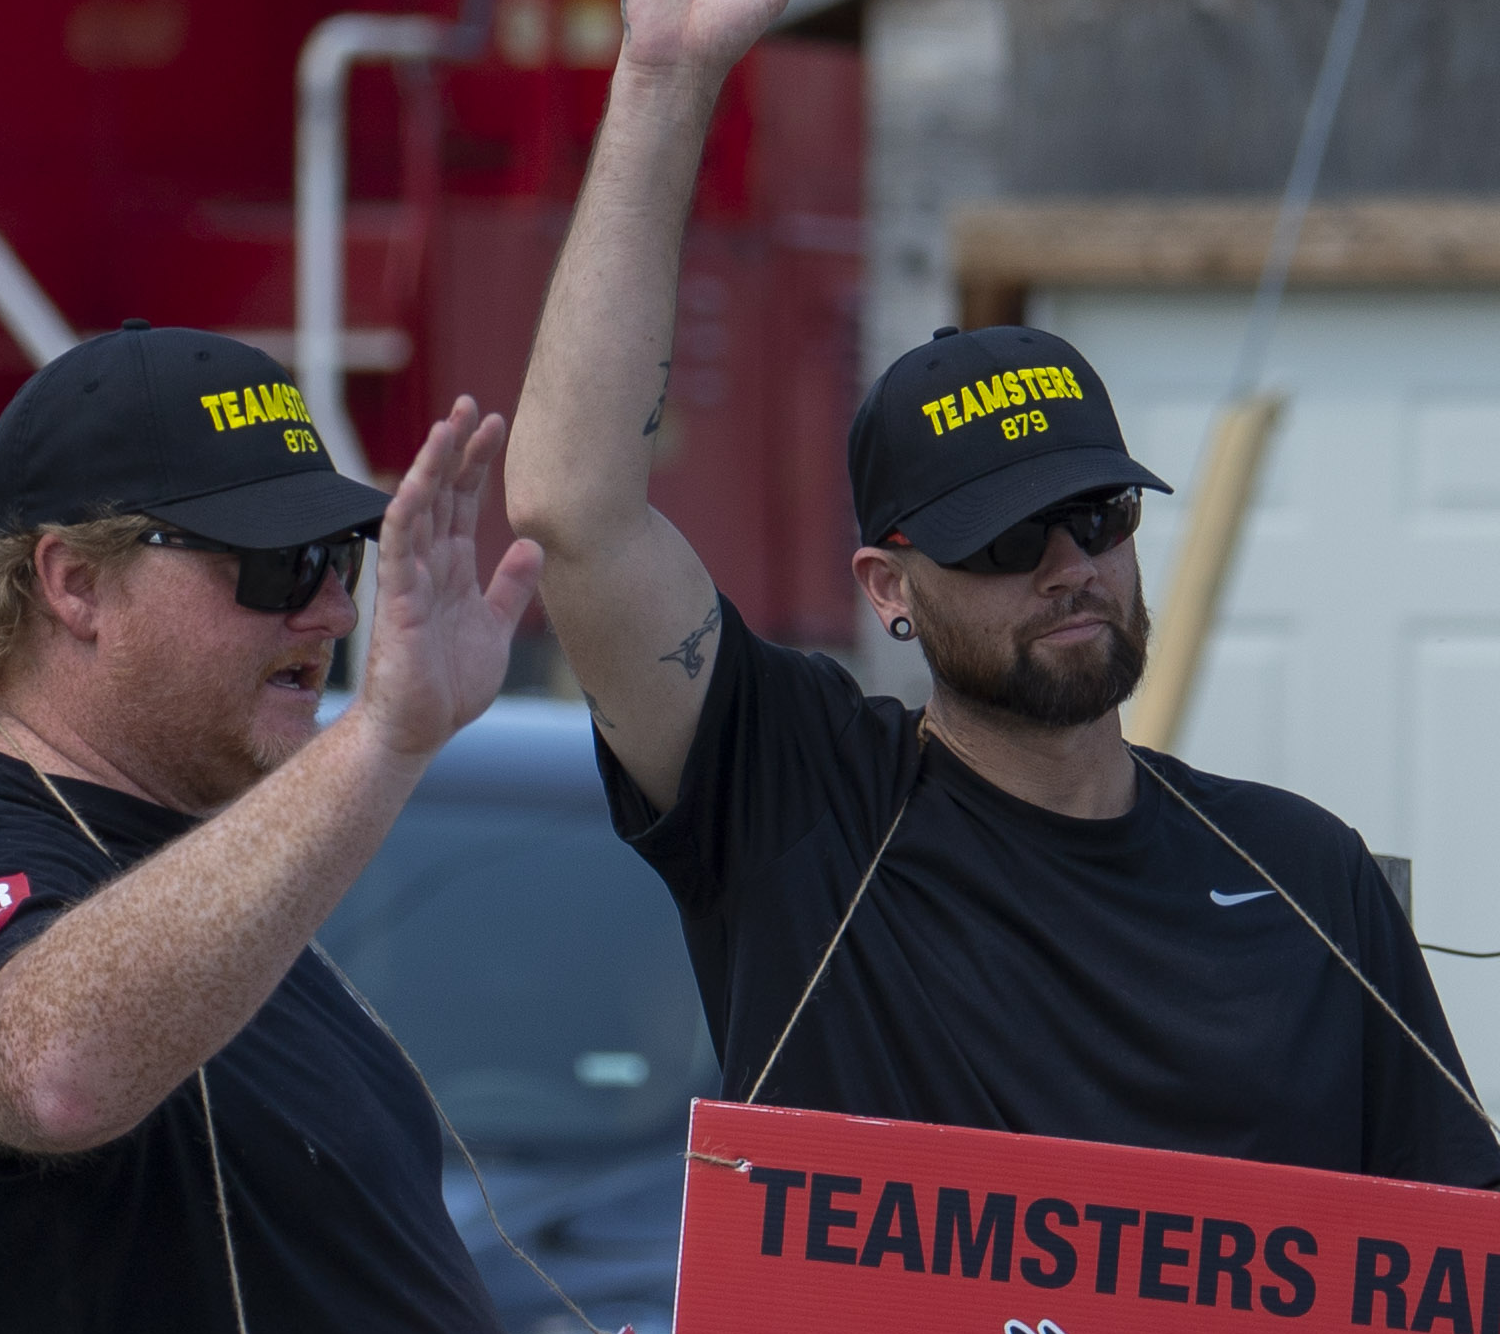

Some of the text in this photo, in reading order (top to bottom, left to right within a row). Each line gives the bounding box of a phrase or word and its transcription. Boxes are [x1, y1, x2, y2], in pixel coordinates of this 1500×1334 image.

[921, 366, 1083, 436] TEAMSTERS
[1001, 410, 1049, 440] 879
[283, 429, 318, 452] 879
[749, 1166, 1318, 1318] TEAMSTERS
